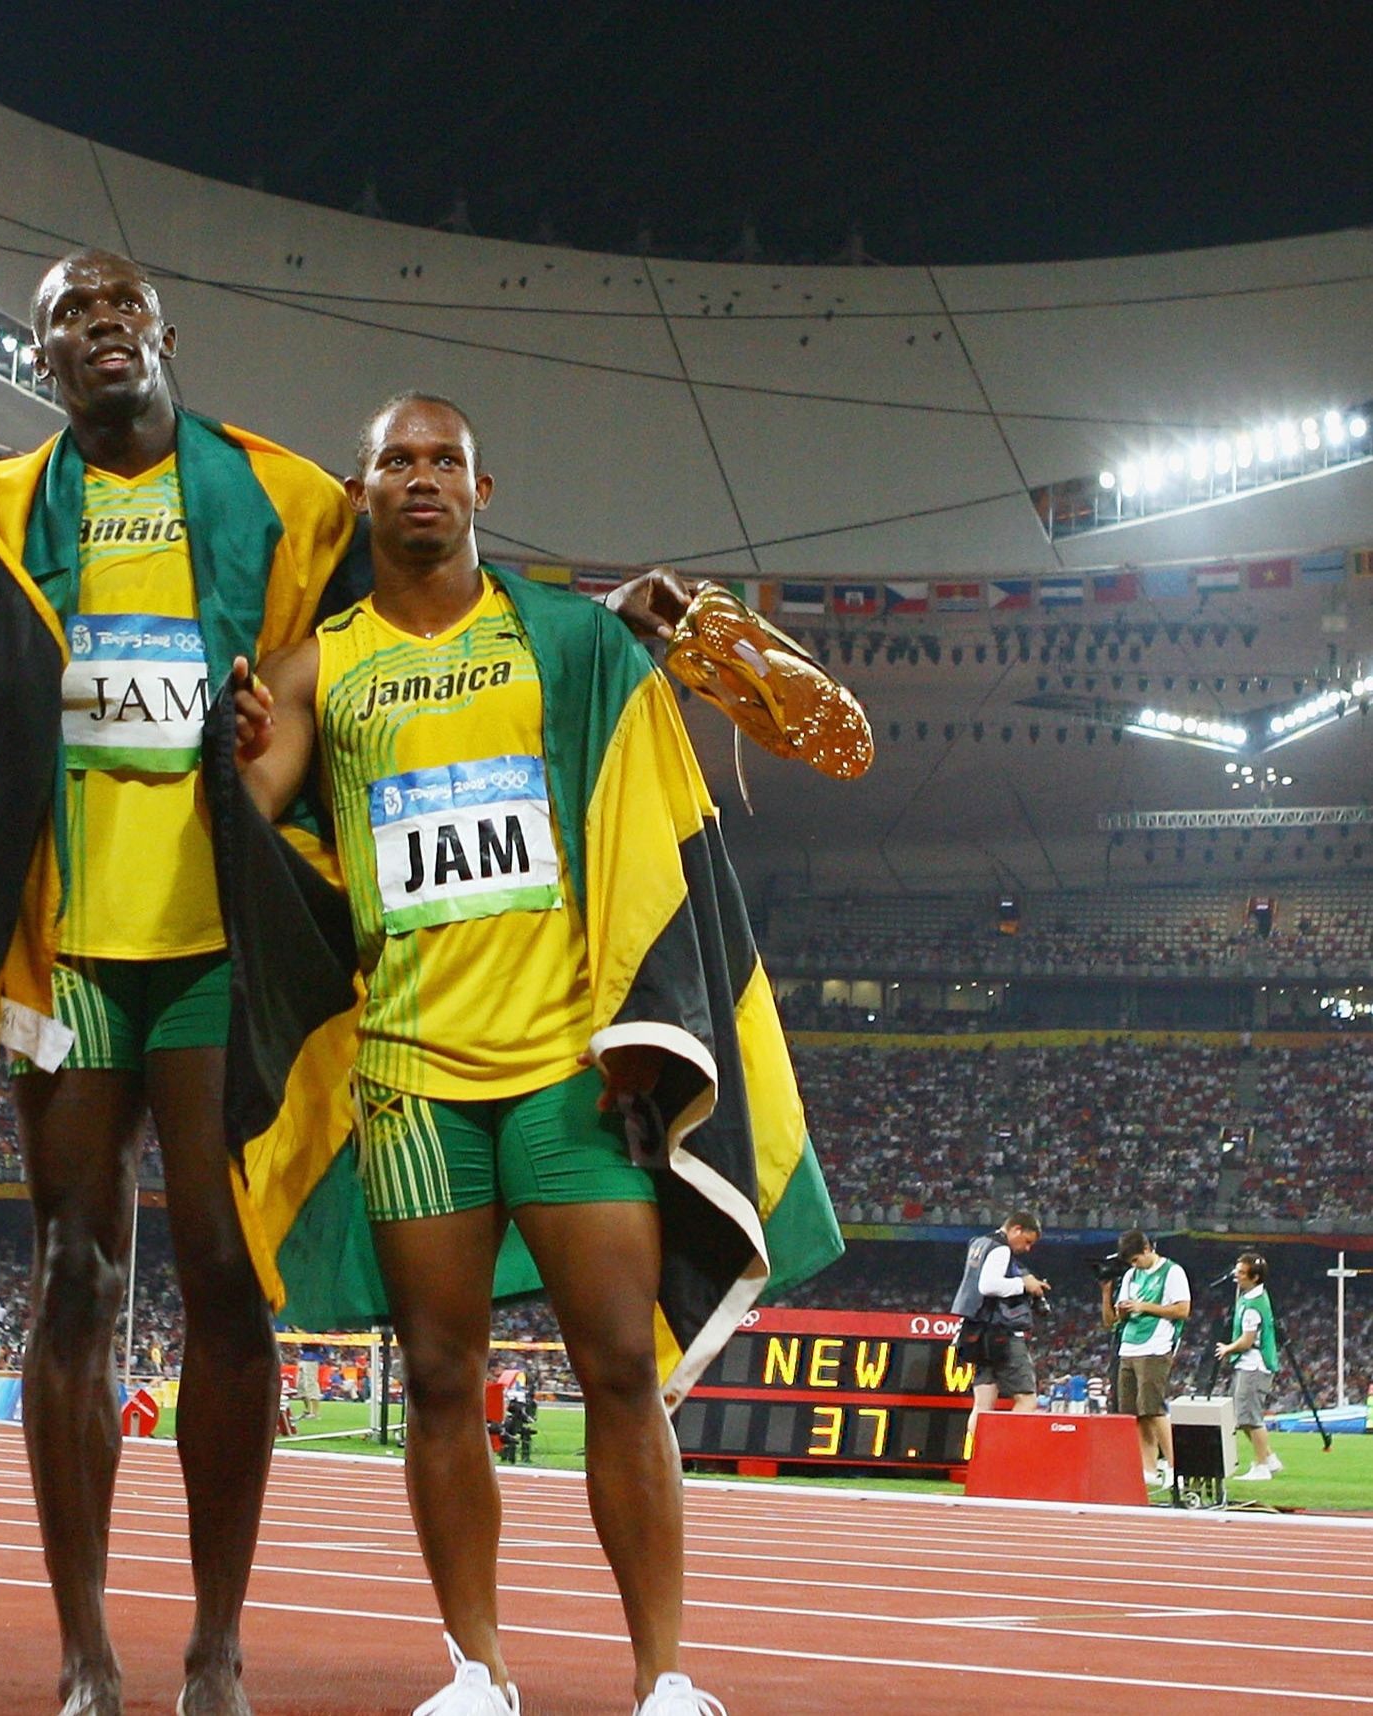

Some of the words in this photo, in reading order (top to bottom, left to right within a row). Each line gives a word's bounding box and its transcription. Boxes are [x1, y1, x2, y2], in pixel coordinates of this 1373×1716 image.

[90, 676, 209, 723] JAM
[357, 660, 512, 722] jamaica
[405, 814, 530, 894] JAM
[763, 1337, 890, 1389] NEW
